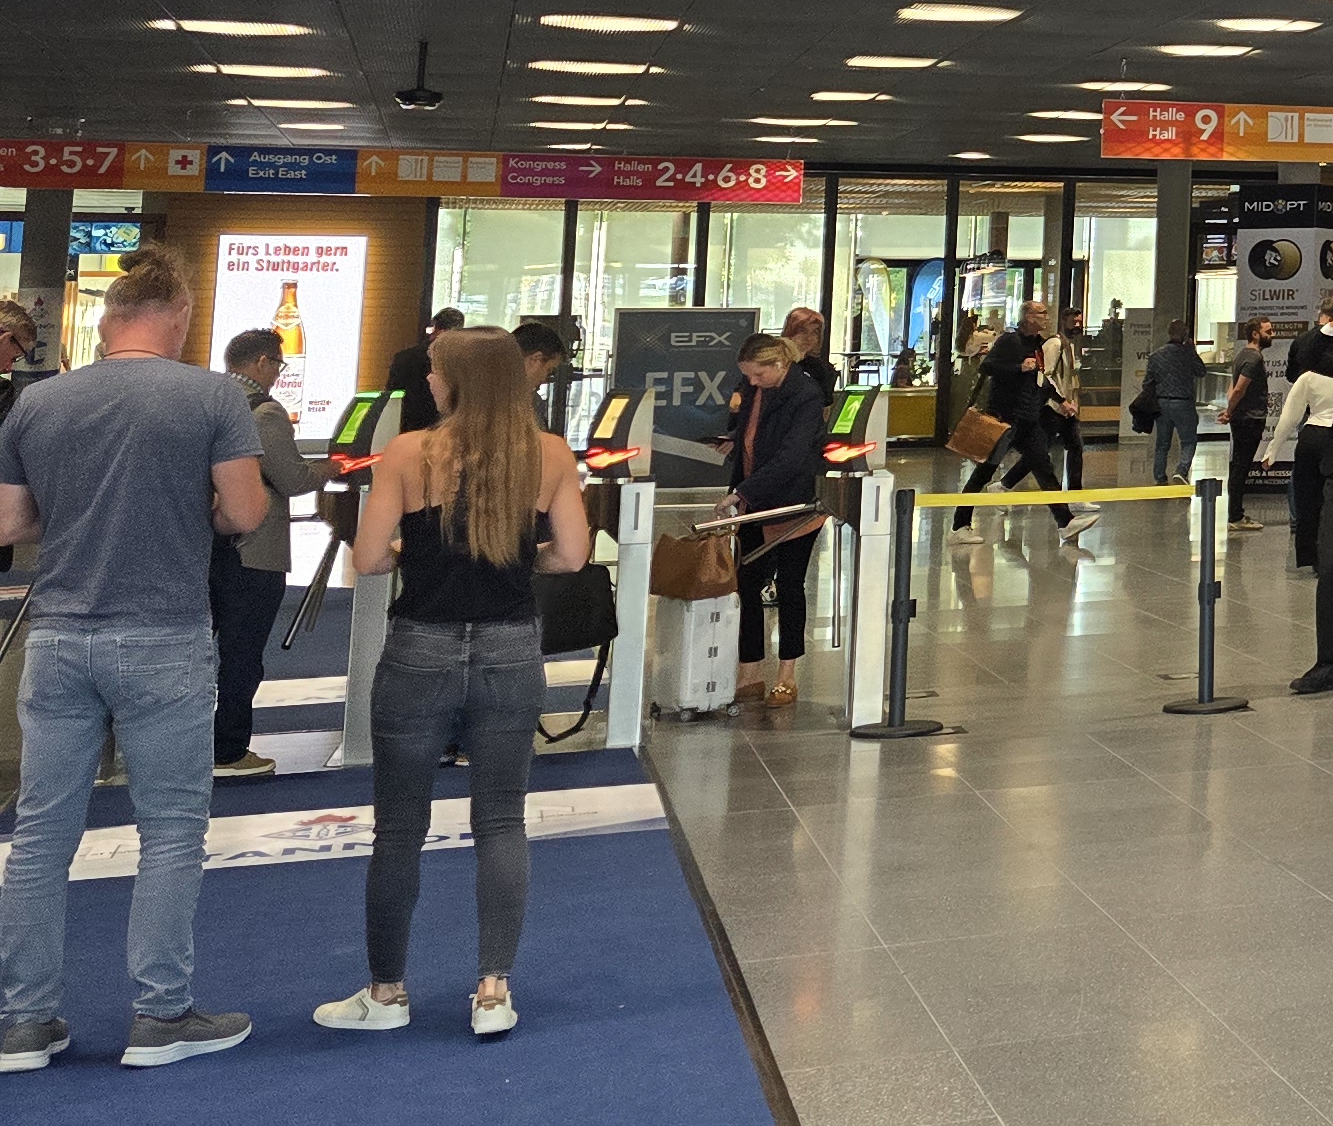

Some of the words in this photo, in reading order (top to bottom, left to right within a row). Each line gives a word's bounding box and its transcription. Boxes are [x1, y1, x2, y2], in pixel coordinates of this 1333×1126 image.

[1149, 108, 1185, 122] Halle
[1149, 127, 1176, 140] Hall
[249, 151, 309, 166] Ausgang
[312, 151, 337, 164] Ost
[508, 158, 567, 172] Kongress
[248, 166, 273, 179] Exit
[278, 168, 307, 179] East
[614, 161, 652, 172] Hallen
[508, 173, 565, 185] Congress
[614, 175, 642, 187] Halls
[228, 242, 259, 257] Fürs
[264, 242, 310, 257] Leben
[315, 245, 348, 259] gern
[227, 259, 249, 272] ein
[255, 258, 340, 274] Stuttgarter.
[670, 332, 732, 346] EFX
